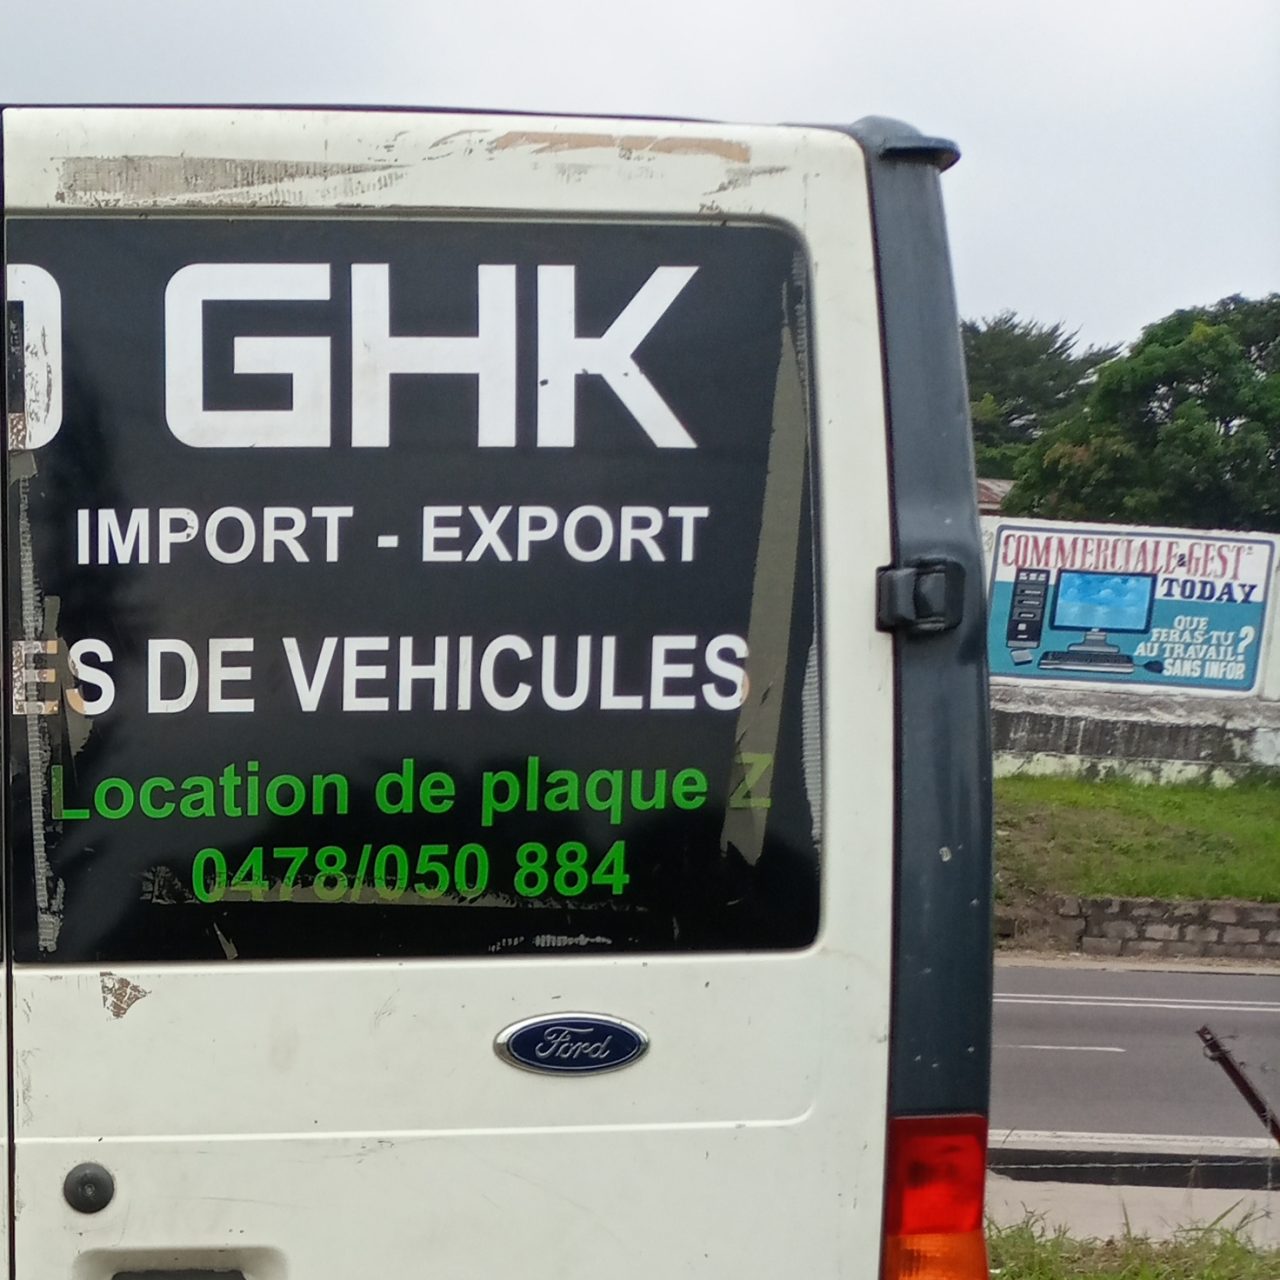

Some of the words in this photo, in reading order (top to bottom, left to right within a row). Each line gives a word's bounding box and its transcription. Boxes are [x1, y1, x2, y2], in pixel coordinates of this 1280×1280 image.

[165, 263, 699, 448] GHK
[77, 506, 354, 565] IMPORT
[422, 506, 710, 563] EXPORT
[1002, 533, 1178, 572] COMMERCIALE
[1161, 577, 1258, 604] TODAY
[1173, 615, 1209, 631] QUE
[1134, 642, 1156, 657] AU
[1161, 643, 1237, 662] TRAVAIL
[1162, 659, 1202, 677] SANS
[1203, 661, 1245, 681] INFOR
[147, 637, 256, 714] DE
[282, 634, 750, 713] VEHICULES
[50, 760, 350, 820] Location
[375, 758, 457, 815] de
[481, 755, 709, 826] plaque
[728, 752, 772, 809] Z
[191, 843, 490, 903] 0478/050
[513, 840, 630, 899] 884
[534, 1026, 614, 1060] Ford
